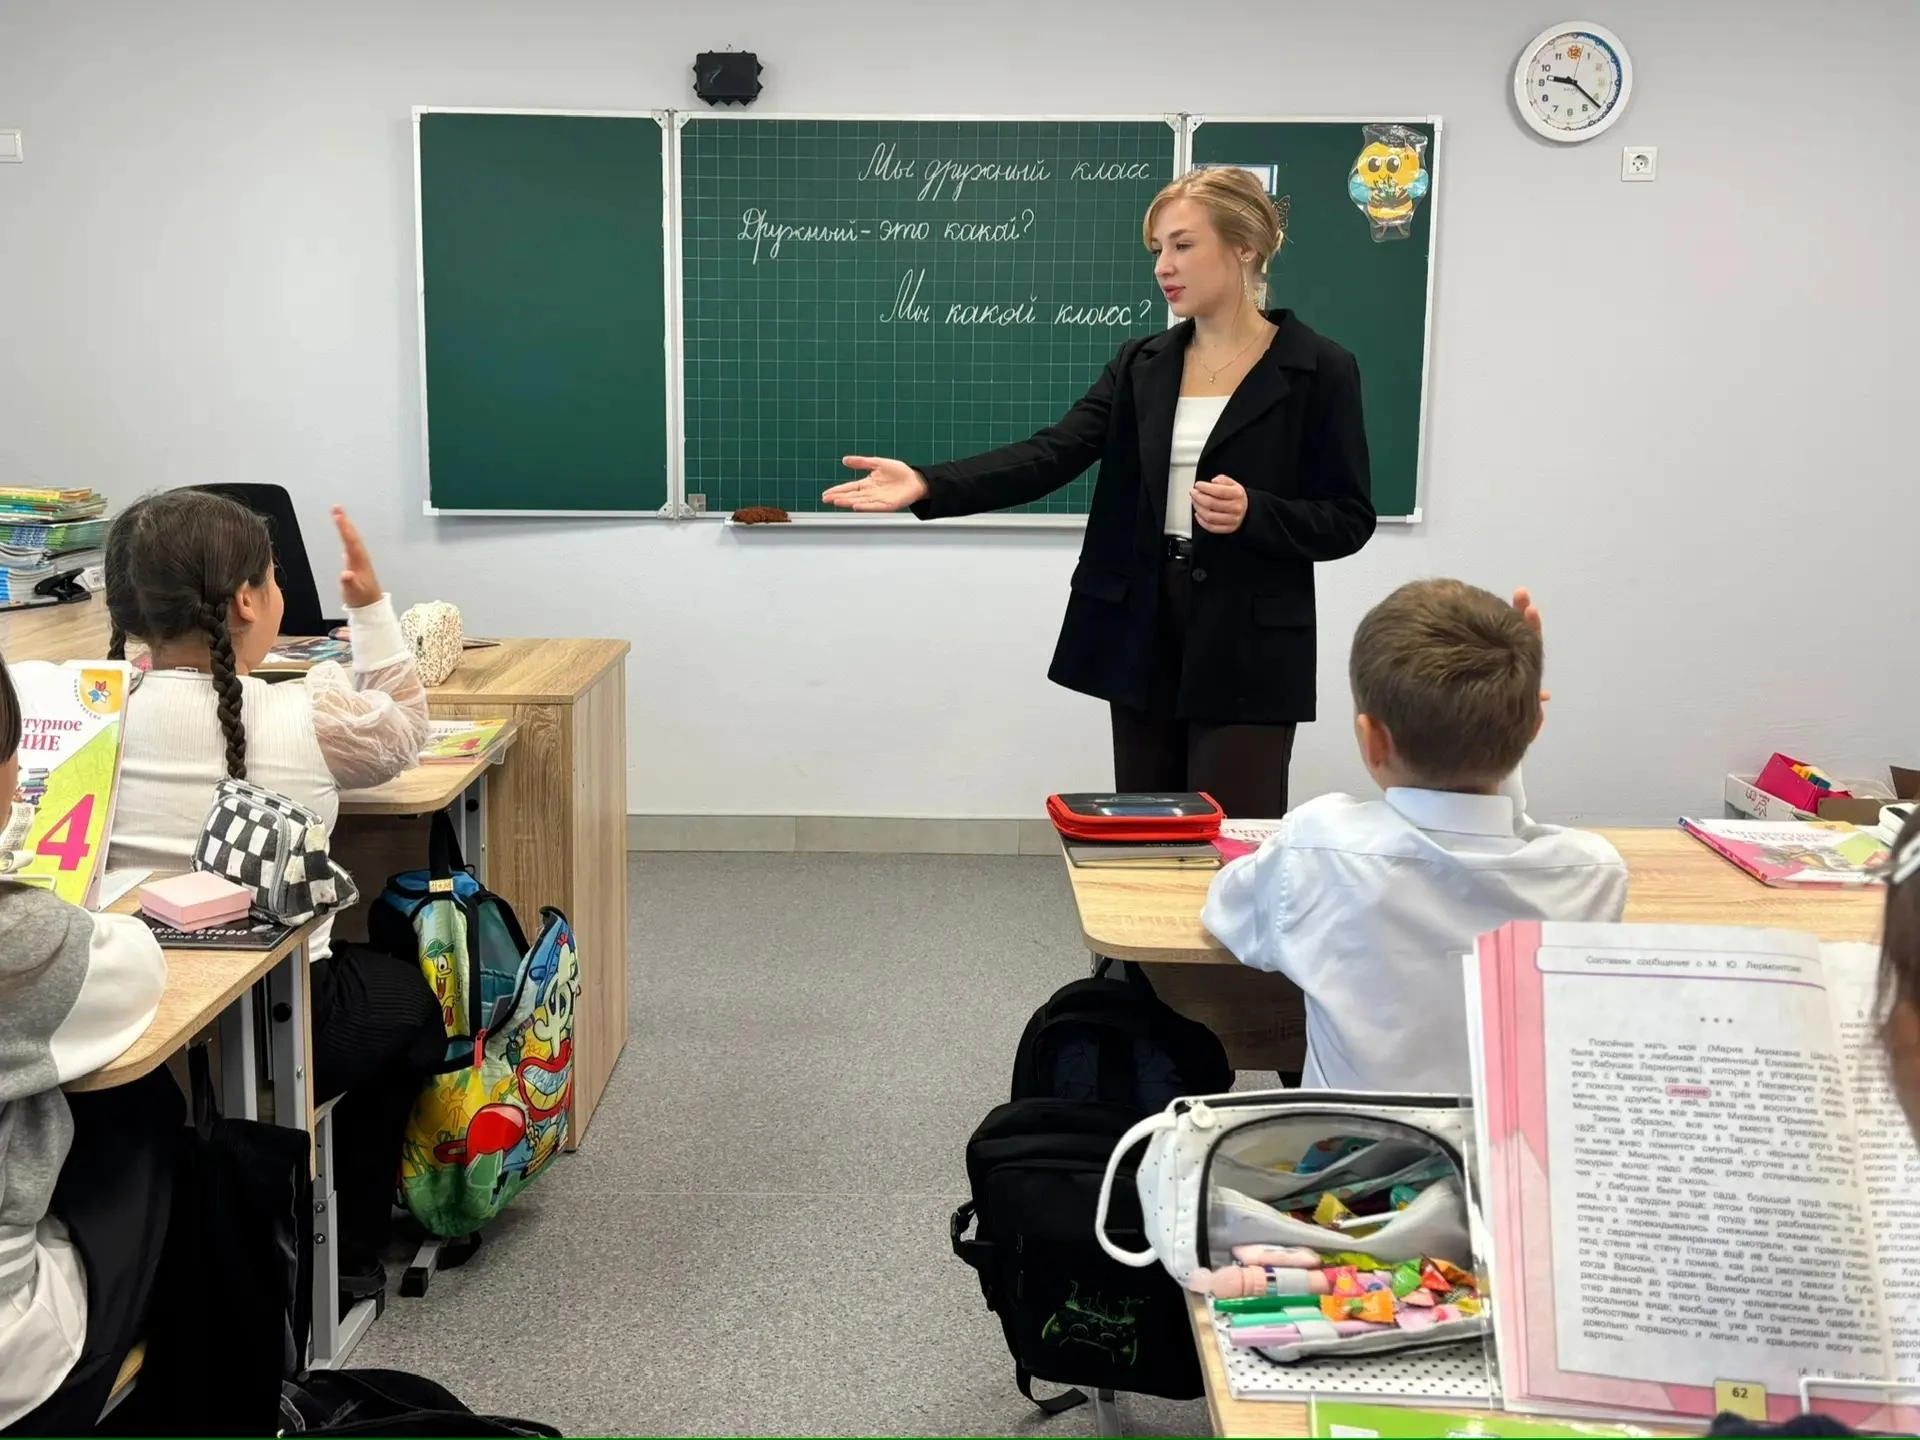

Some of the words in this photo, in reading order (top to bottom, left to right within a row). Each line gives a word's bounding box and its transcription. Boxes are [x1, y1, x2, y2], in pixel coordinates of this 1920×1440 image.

[1542, 64, 1551, 72] 10
[1552, 105, 1559, 113] 7
[1582, 104, 1588, 112] 5
[858, 142, 915, 181] Мы
[917, 157, 1051, 201] дружный
[1071, 158, 1150, 181] класс
[879, 220, 929, 242] это
[943, 209, 1035, 243] какой?
[880, 268, 929, 325] Мы
[944, 296, 1037, 326] какой
[1054, 299, 1152, 327] класс?
[22, 718, 83, 733] турное
[18, 734, 61, 751] НИЕ
[36, 793, 95, 871] 4
[1731, 1387, 1749, 1399] 62
